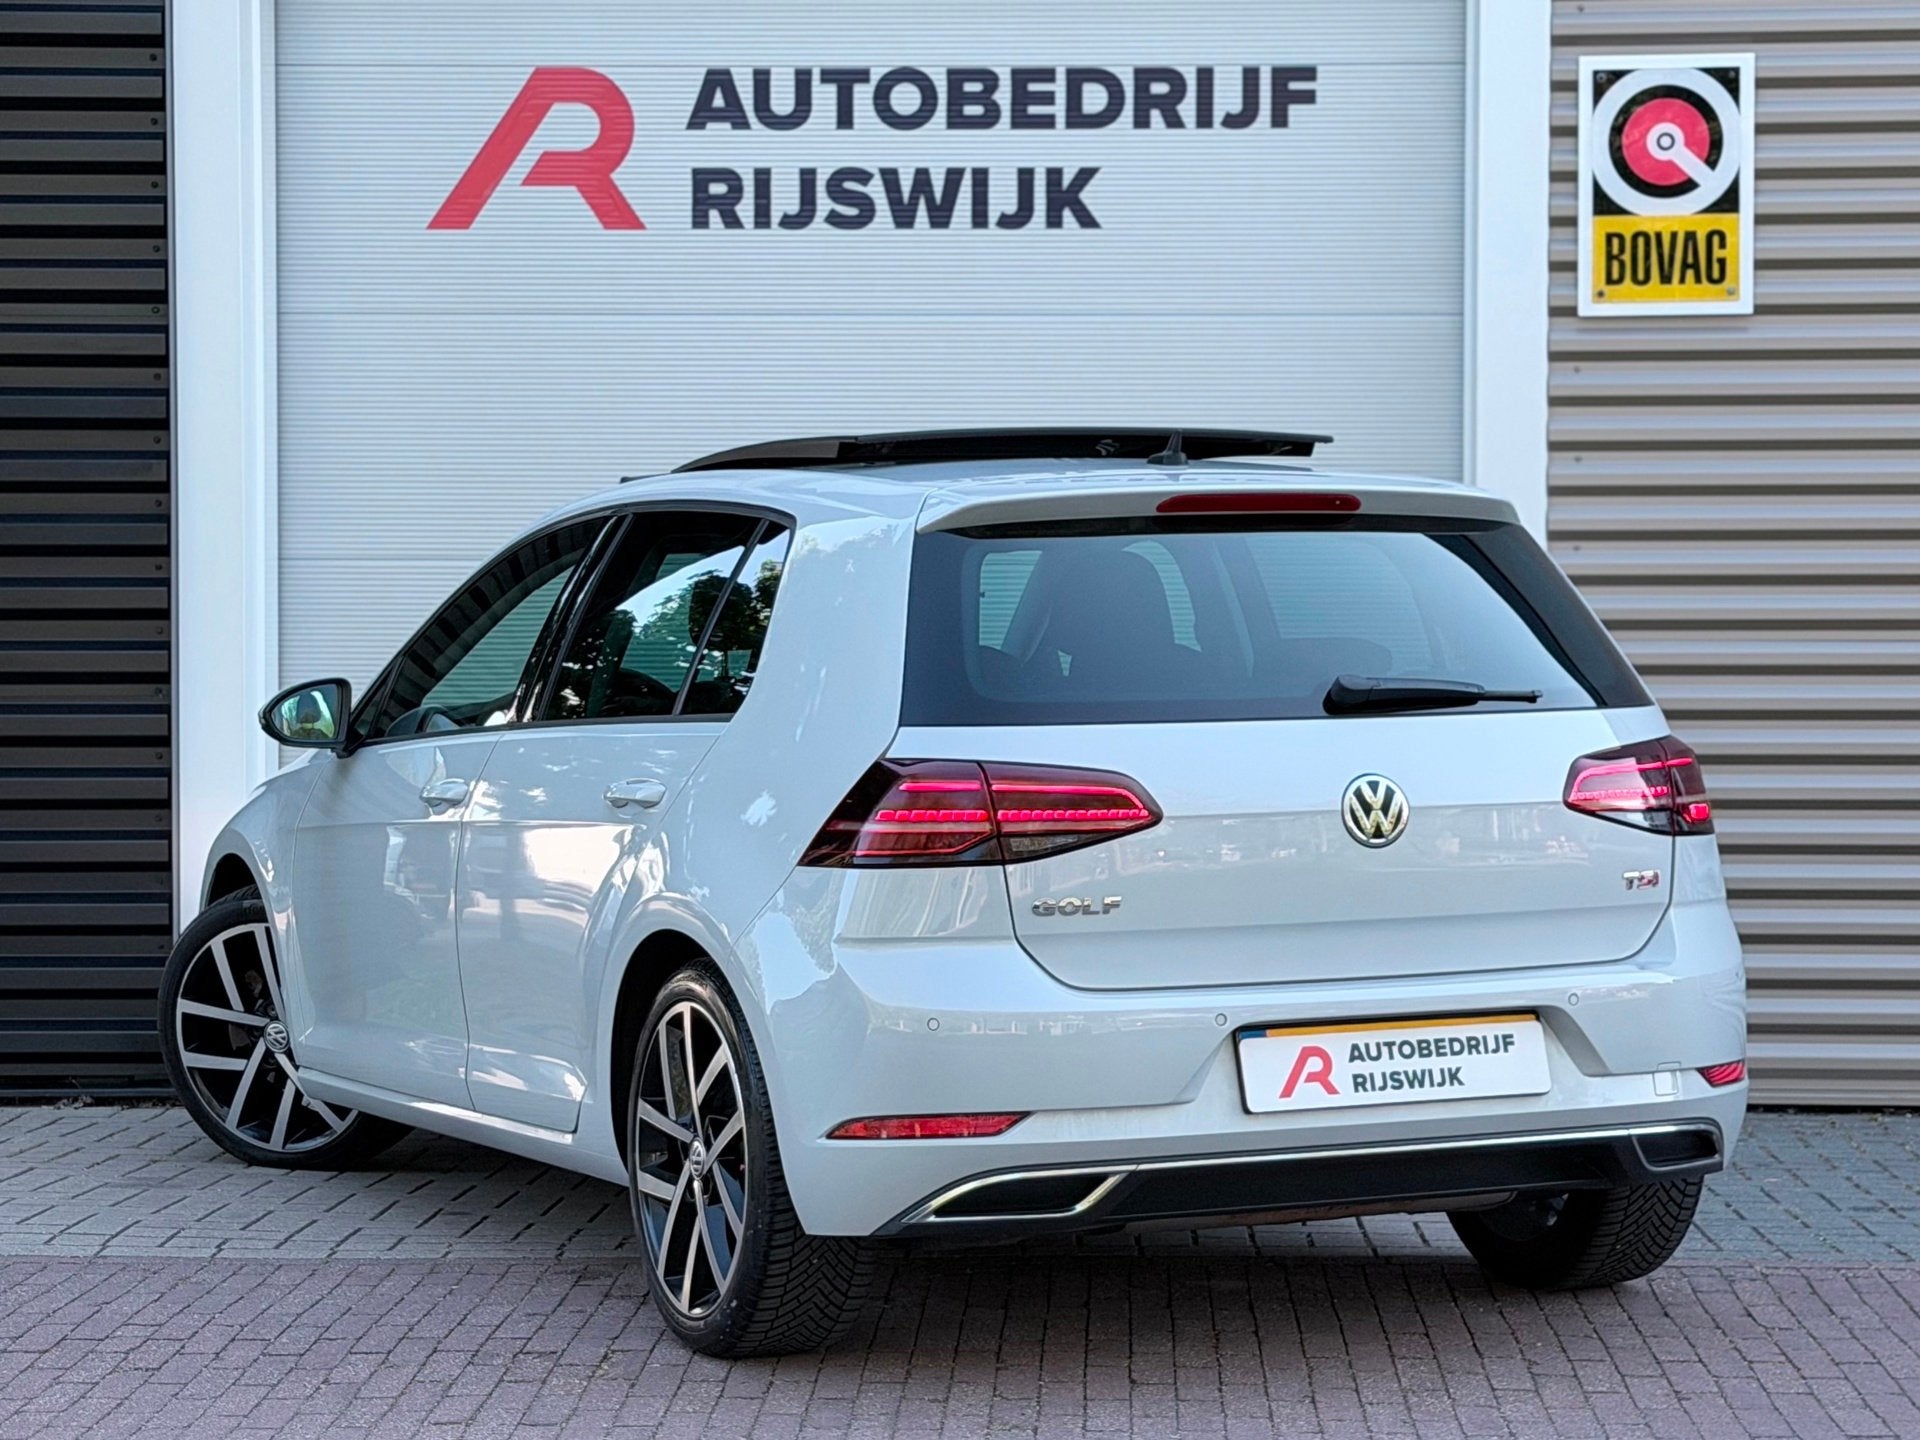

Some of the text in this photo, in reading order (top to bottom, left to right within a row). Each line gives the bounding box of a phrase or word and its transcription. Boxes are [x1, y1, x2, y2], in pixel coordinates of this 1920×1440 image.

[686, 66, 1318, 131] AUTOBEDRIJF
[690, 167, 1102, 230] RIJSWIJK
[1605, 229, 1728, 286] BOVAG
[1031, 896, 1122, 917] GOLF
[1348, 1034, 1515, 1063] AUTOBEDRIJF
[1352, 1067, 1465, 1093] RIJSWIJK
